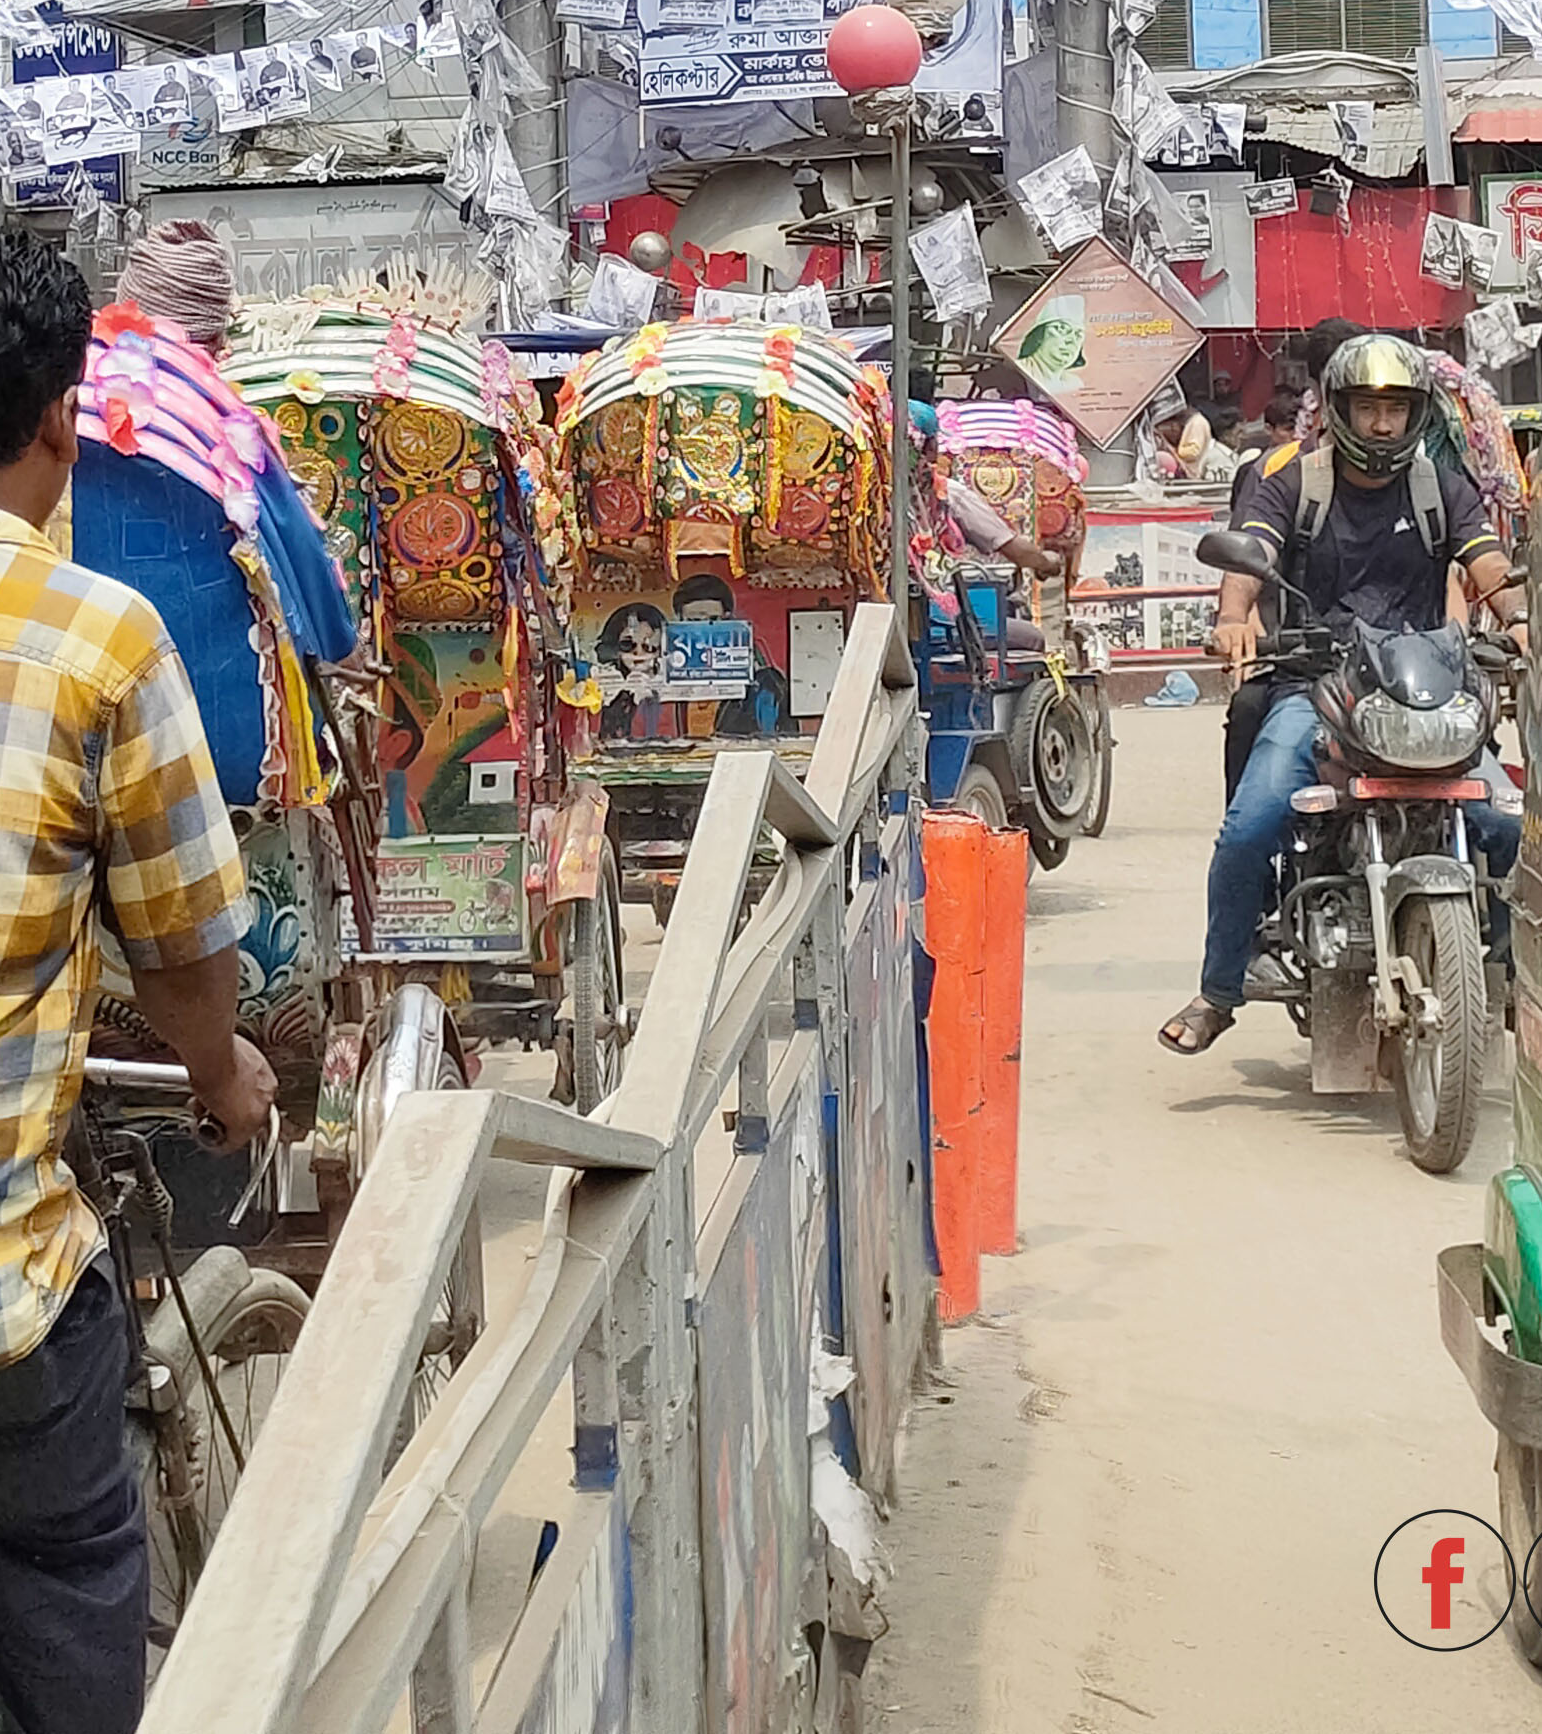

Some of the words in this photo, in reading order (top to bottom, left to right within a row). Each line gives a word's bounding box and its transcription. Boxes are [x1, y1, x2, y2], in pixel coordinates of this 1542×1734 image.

[643, 59, 721, 96] হেলিকপ্টার
[152, 152, 188, 164] NCC
[189, 151, 220, 164] Ban
